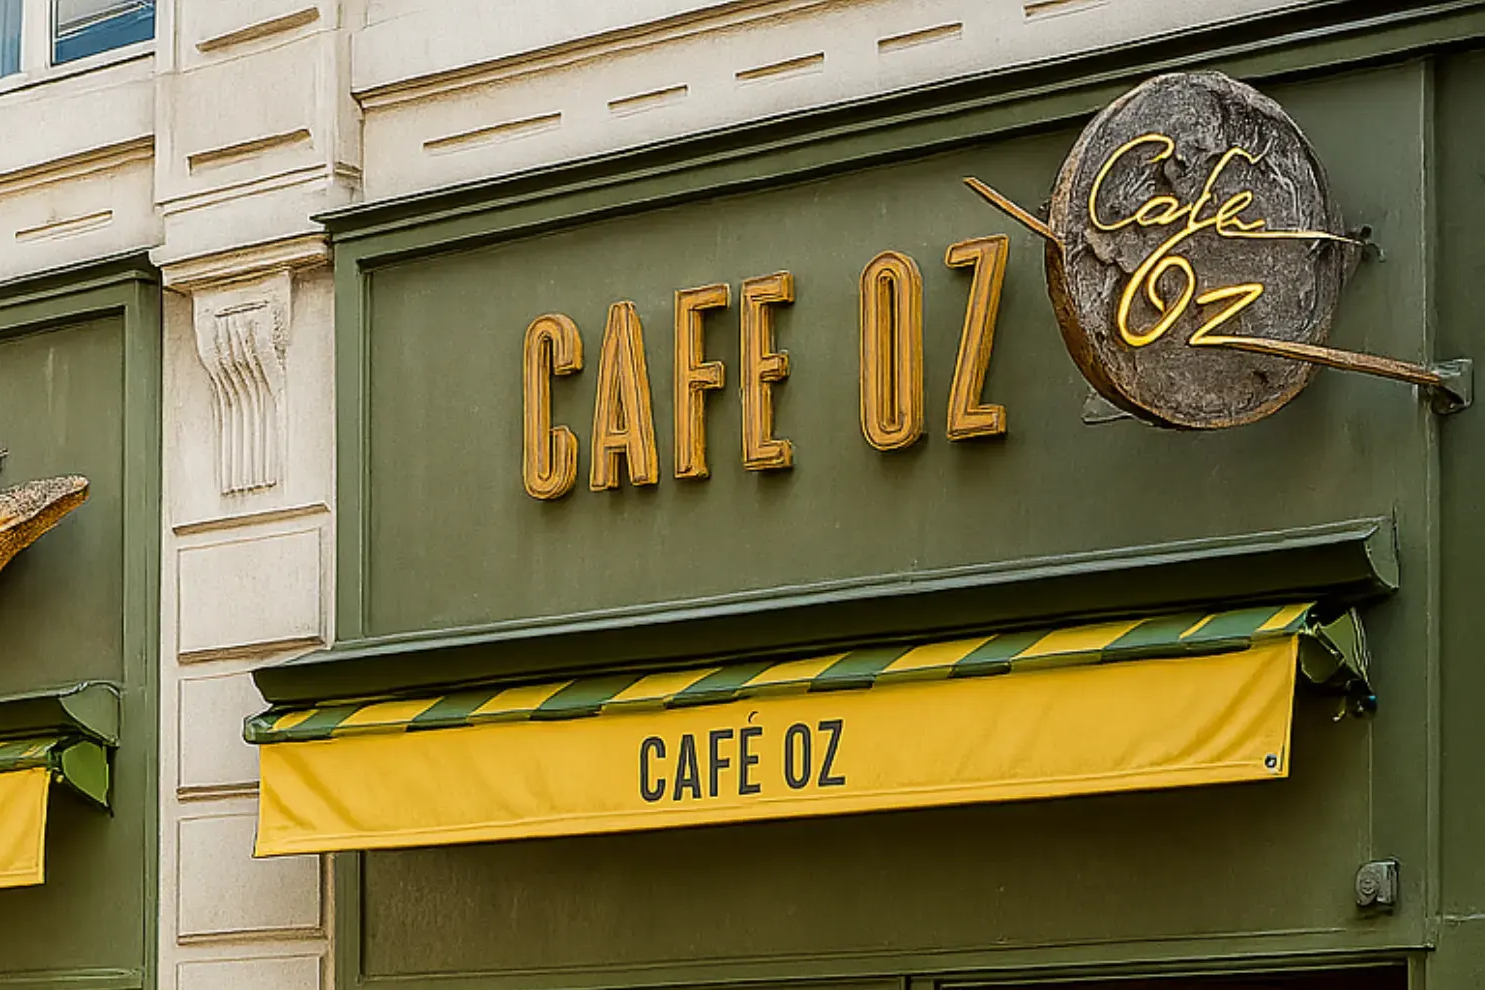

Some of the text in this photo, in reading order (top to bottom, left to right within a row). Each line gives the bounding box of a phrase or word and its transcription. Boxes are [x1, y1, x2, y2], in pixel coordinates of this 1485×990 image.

[1117, 254, 1265, 348] Oz
[523, 233, 1011, 499] CAFE OZ
[640, 711, 846, 802] CAFÉ OZ
